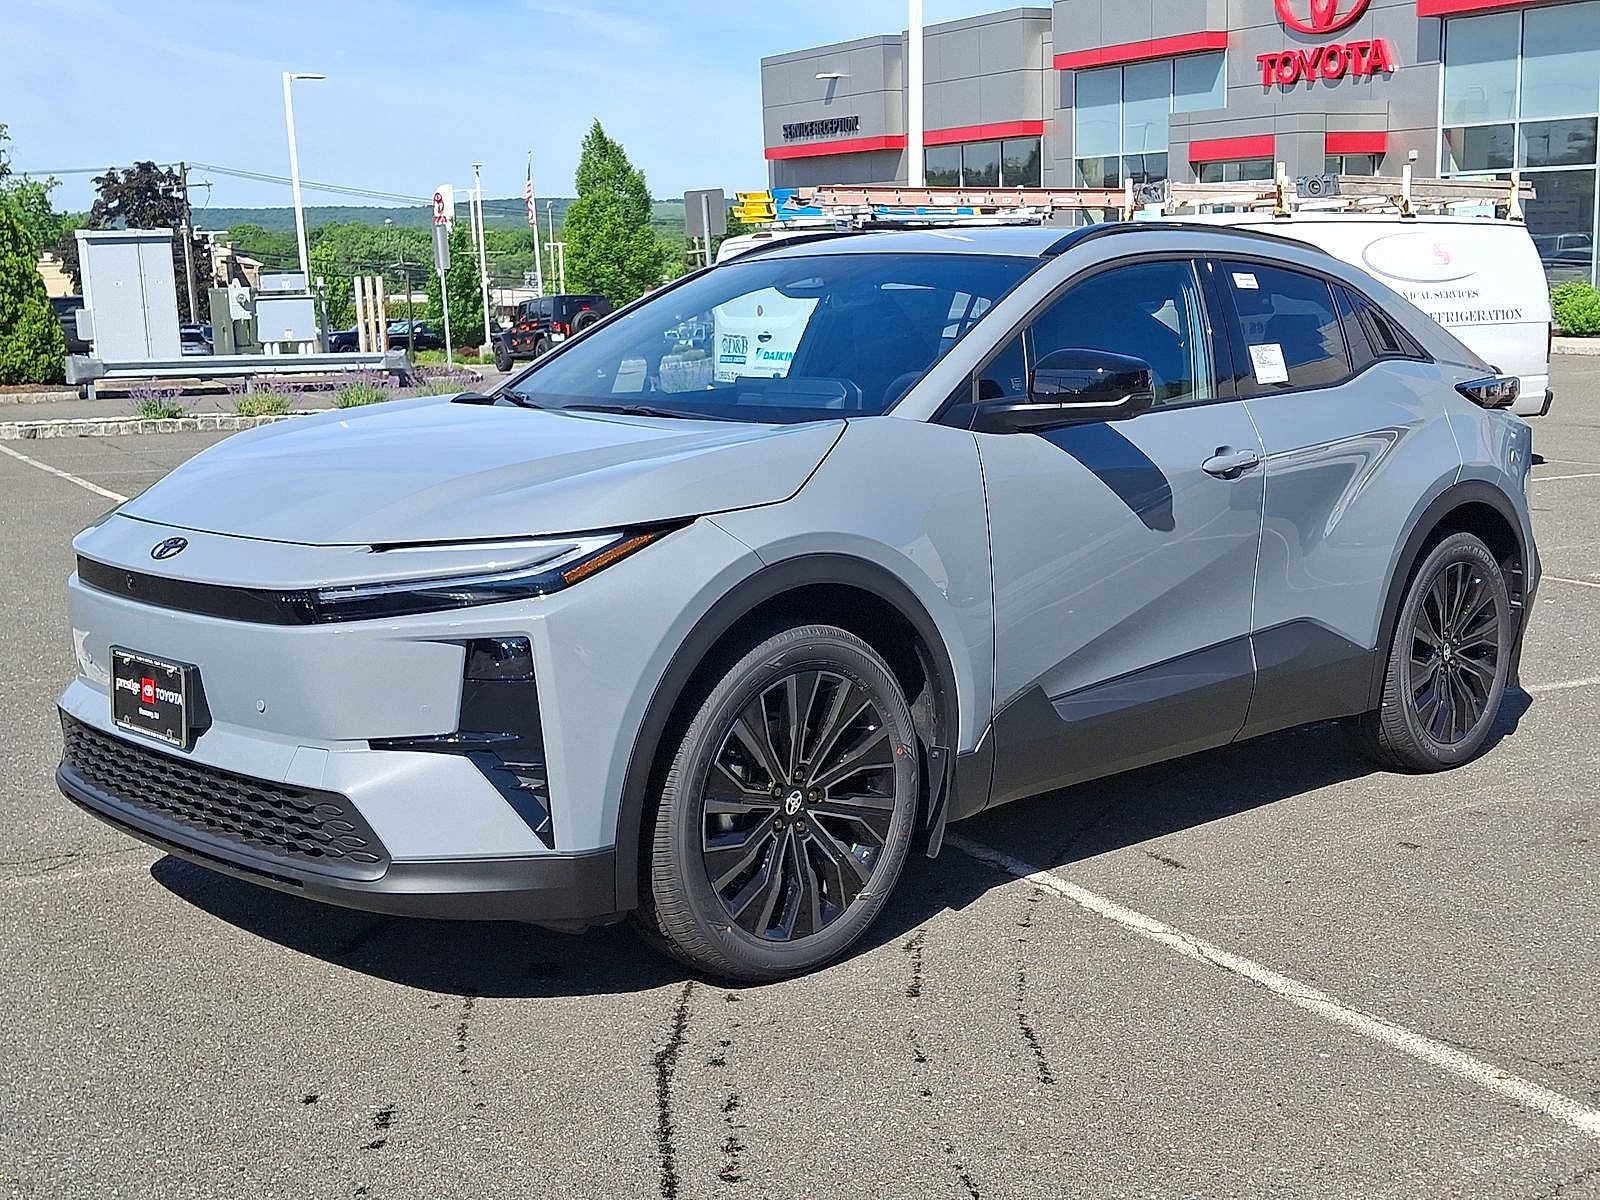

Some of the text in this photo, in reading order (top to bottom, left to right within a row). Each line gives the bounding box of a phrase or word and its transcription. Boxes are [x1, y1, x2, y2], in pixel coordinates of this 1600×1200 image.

[1257, 38, 1394, 86] TOYOTA
[783, 115, 859, 138] SERVICE RECEPTION
[1434, 289, 1479, 299] SERVICES
[115, 677, 183, 706] prestige TOYOTA
